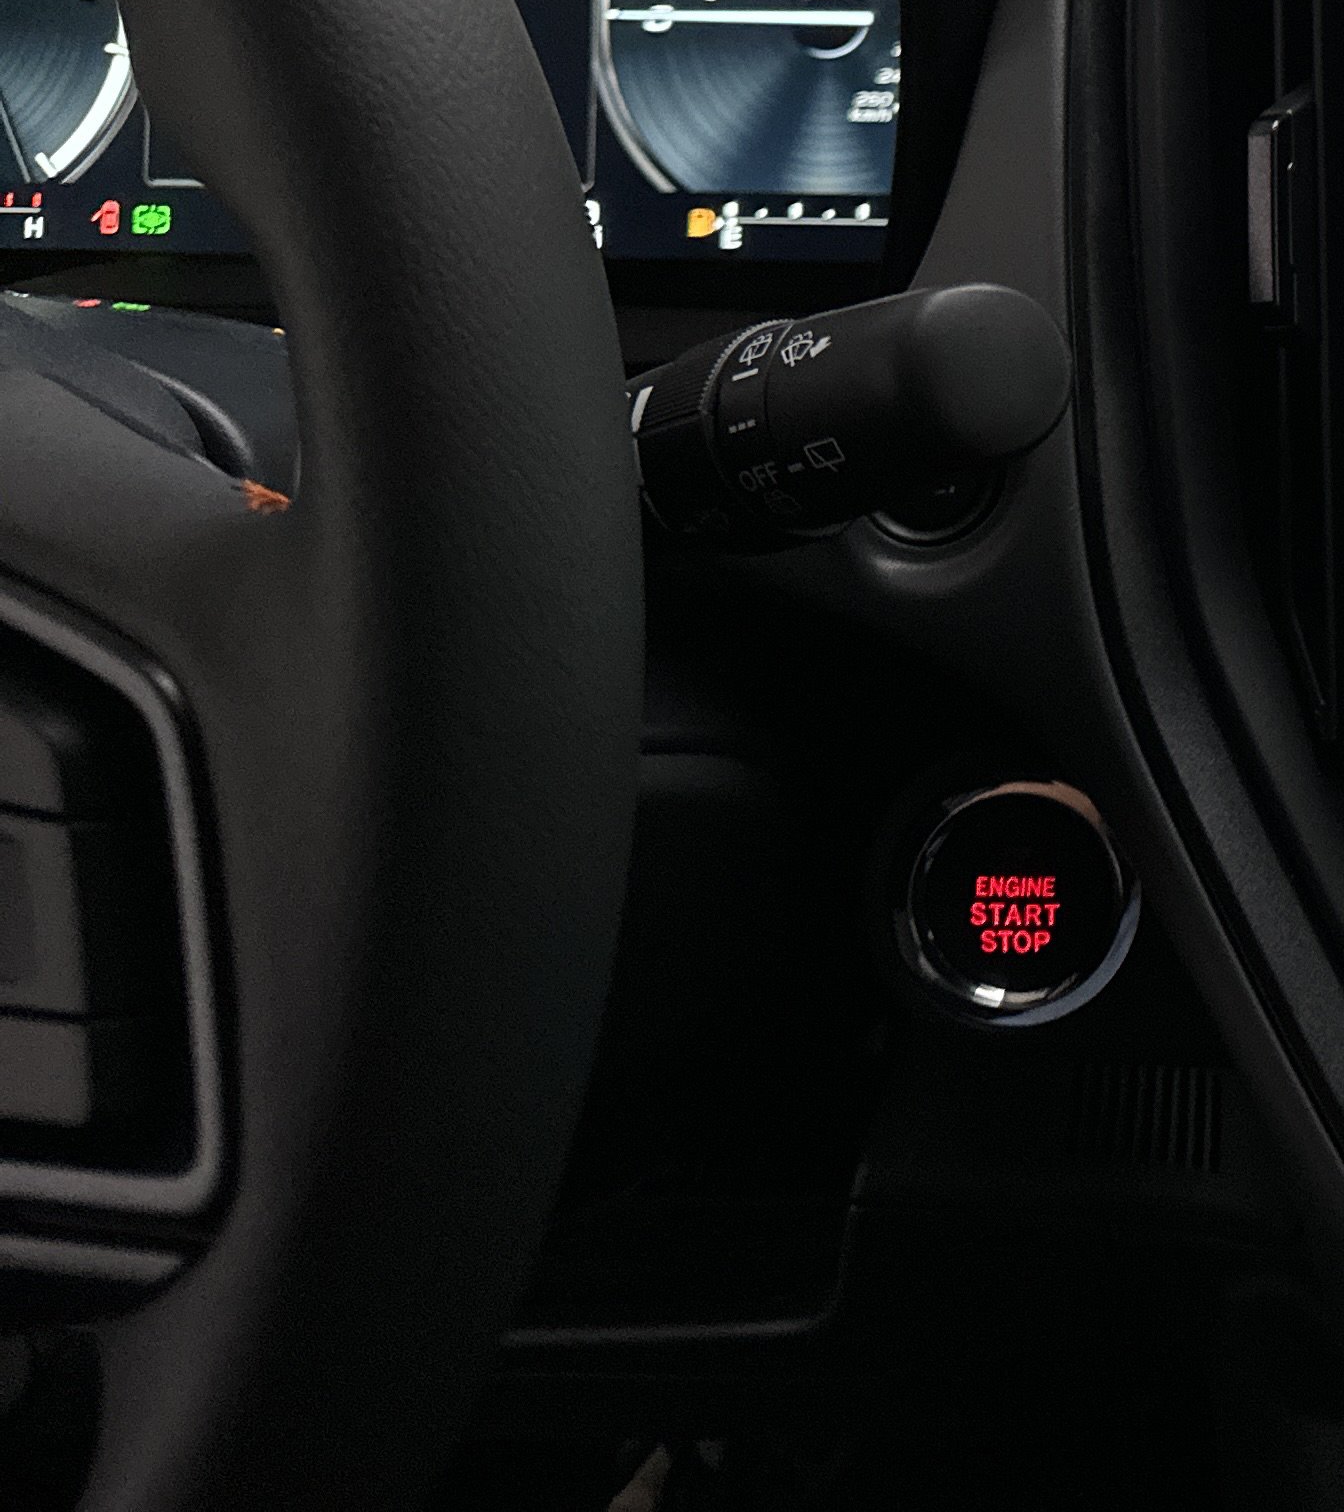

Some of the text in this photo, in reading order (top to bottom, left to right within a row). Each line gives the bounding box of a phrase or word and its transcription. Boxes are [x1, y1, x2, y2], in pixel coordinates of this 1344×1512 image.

[24, 216, 45, 239] H
[718, 225, 743, 250] E
[739, 461, 780, 491] OFF
[975, 875, 1056, 899] ENGINE
[969, 901, 1061, 927] START
[979, 928, 1051, 954] STOP
